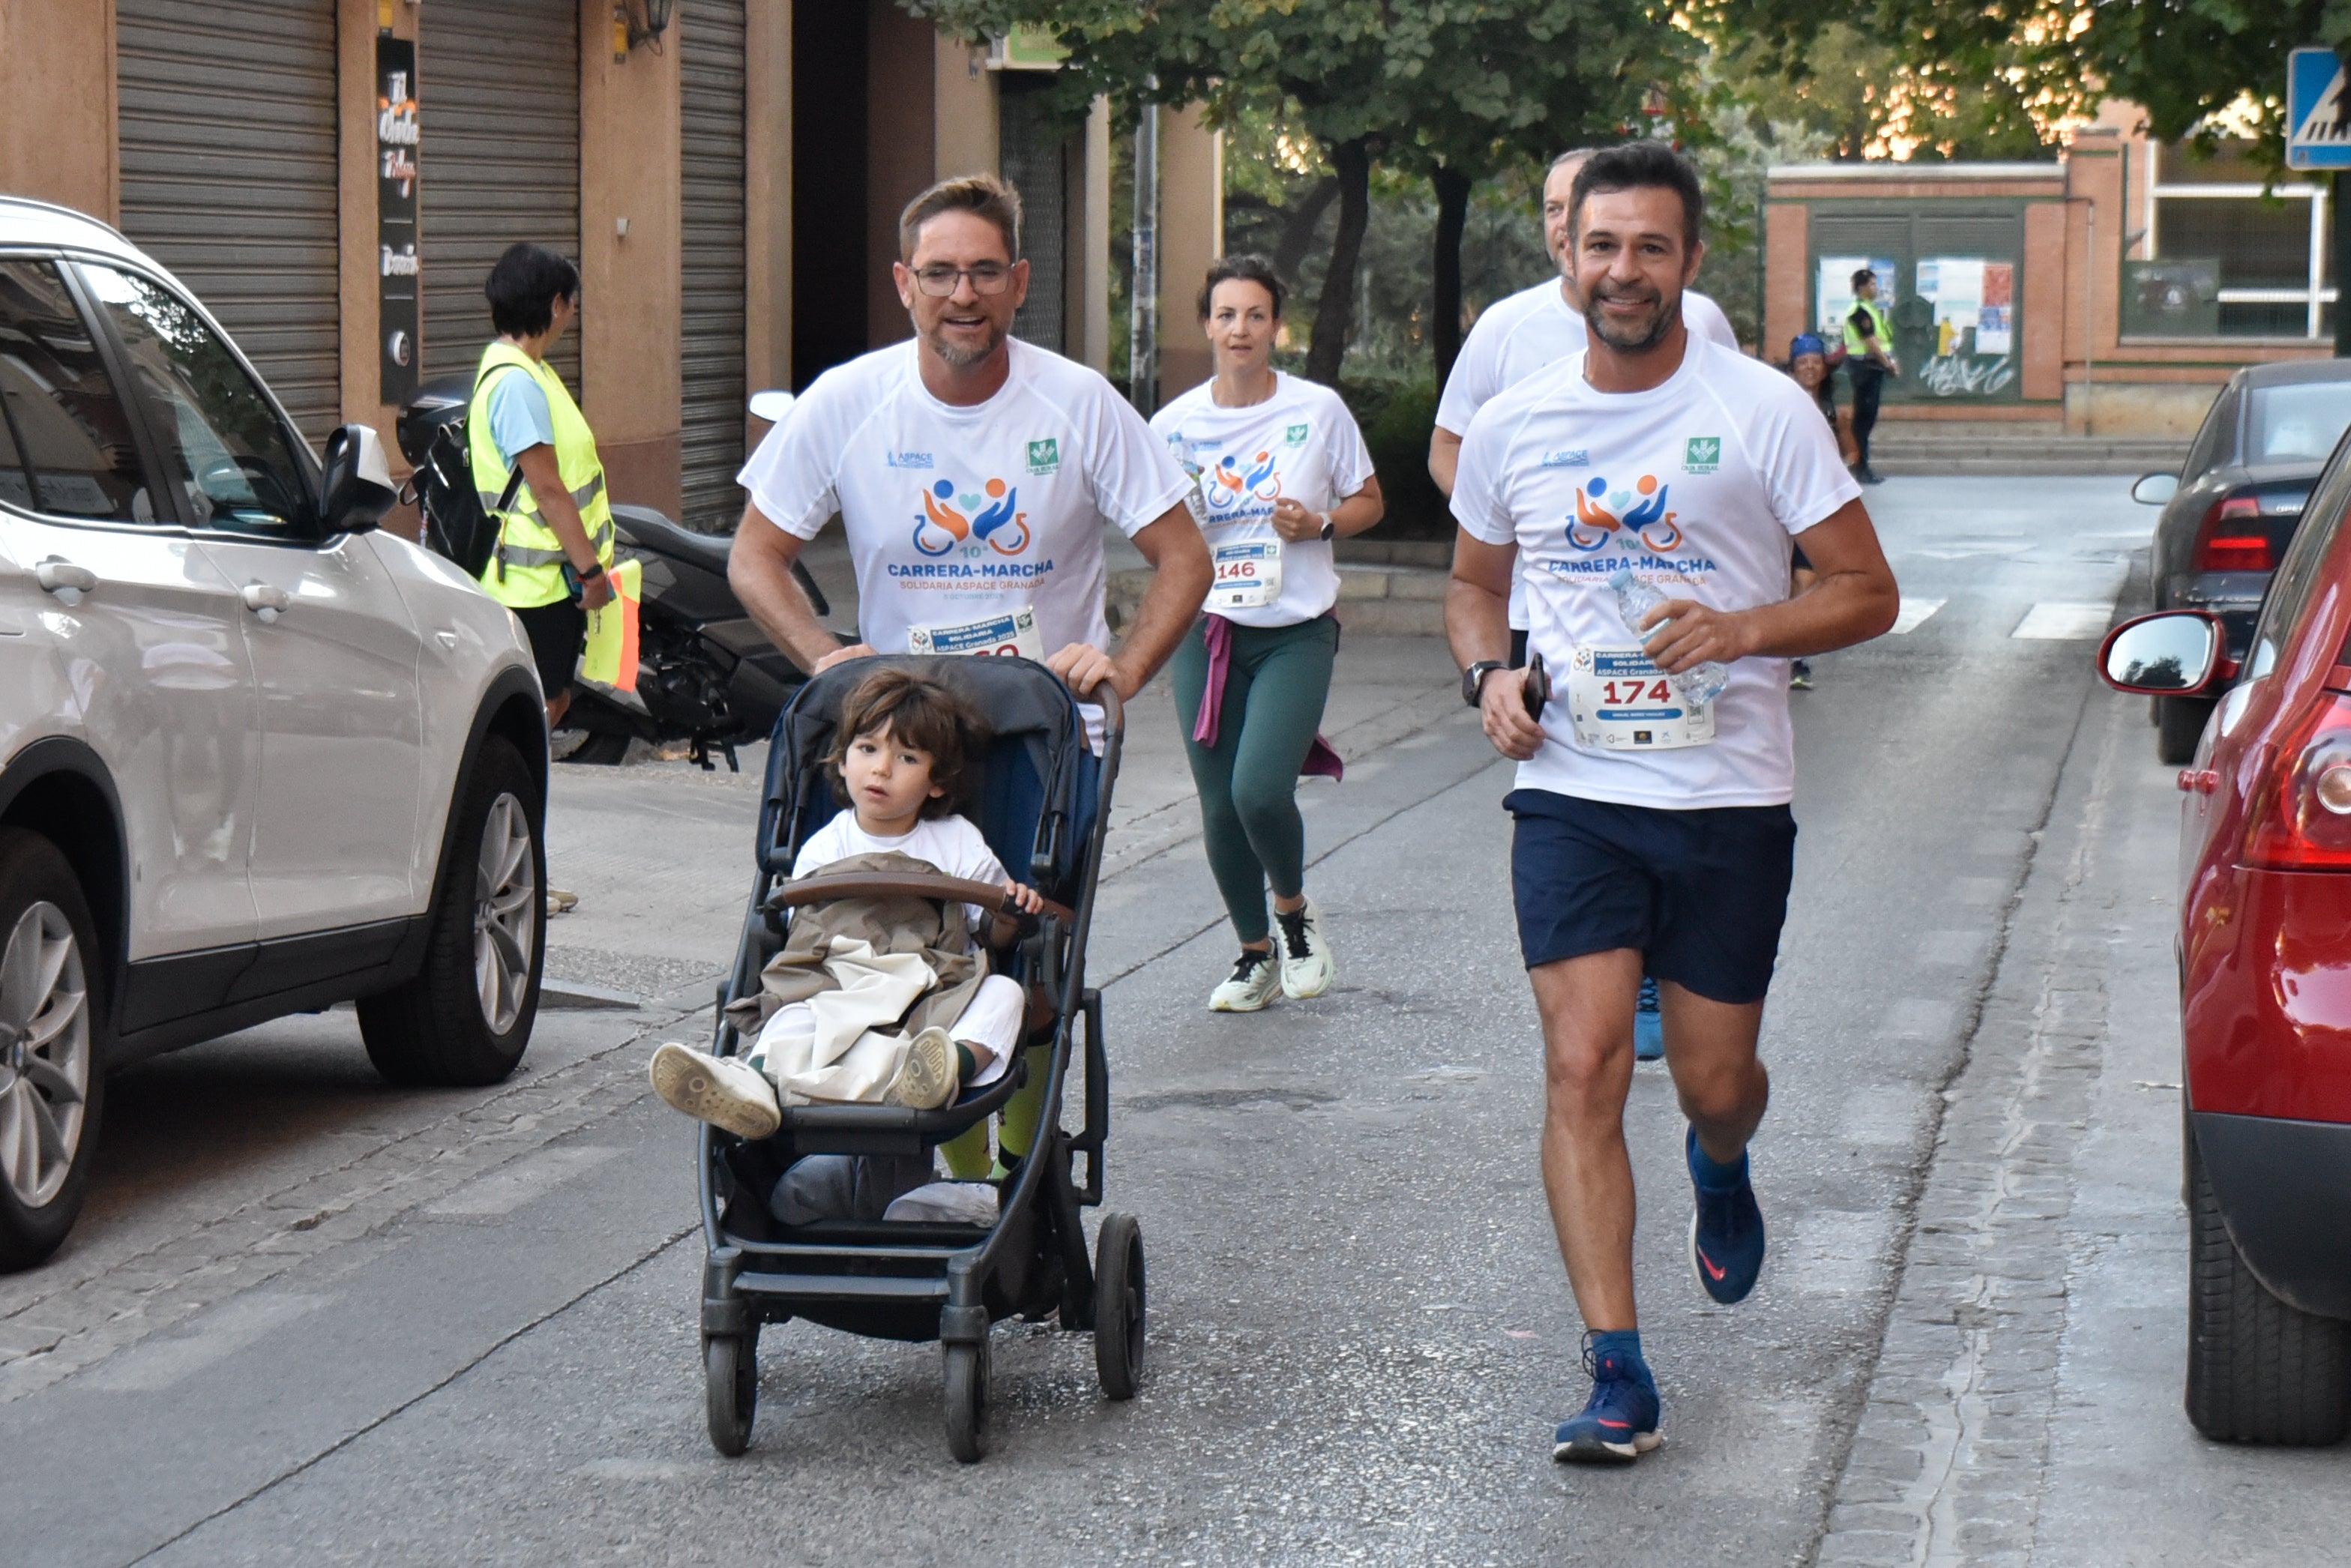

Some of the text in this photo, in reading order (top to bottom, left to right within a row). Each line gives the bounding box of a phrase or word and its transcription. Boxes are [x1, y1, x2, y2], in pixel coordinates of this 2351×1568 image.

[898, 452, 933, 463] ASPACE
[888, 560, 1053, 577] CARRERA-MARCHA
[1217, 561, 1256, 579] 146
[900, 577, 1045, 591] SOLIDARIA ASPACE GRANADA
[948, 629, 993, 642] SOLIDARIA
[936, 642, 964, 652] ASPACE
[966, 636, 996, 648] Granada
[1604, 680, 1670, 704] 174
